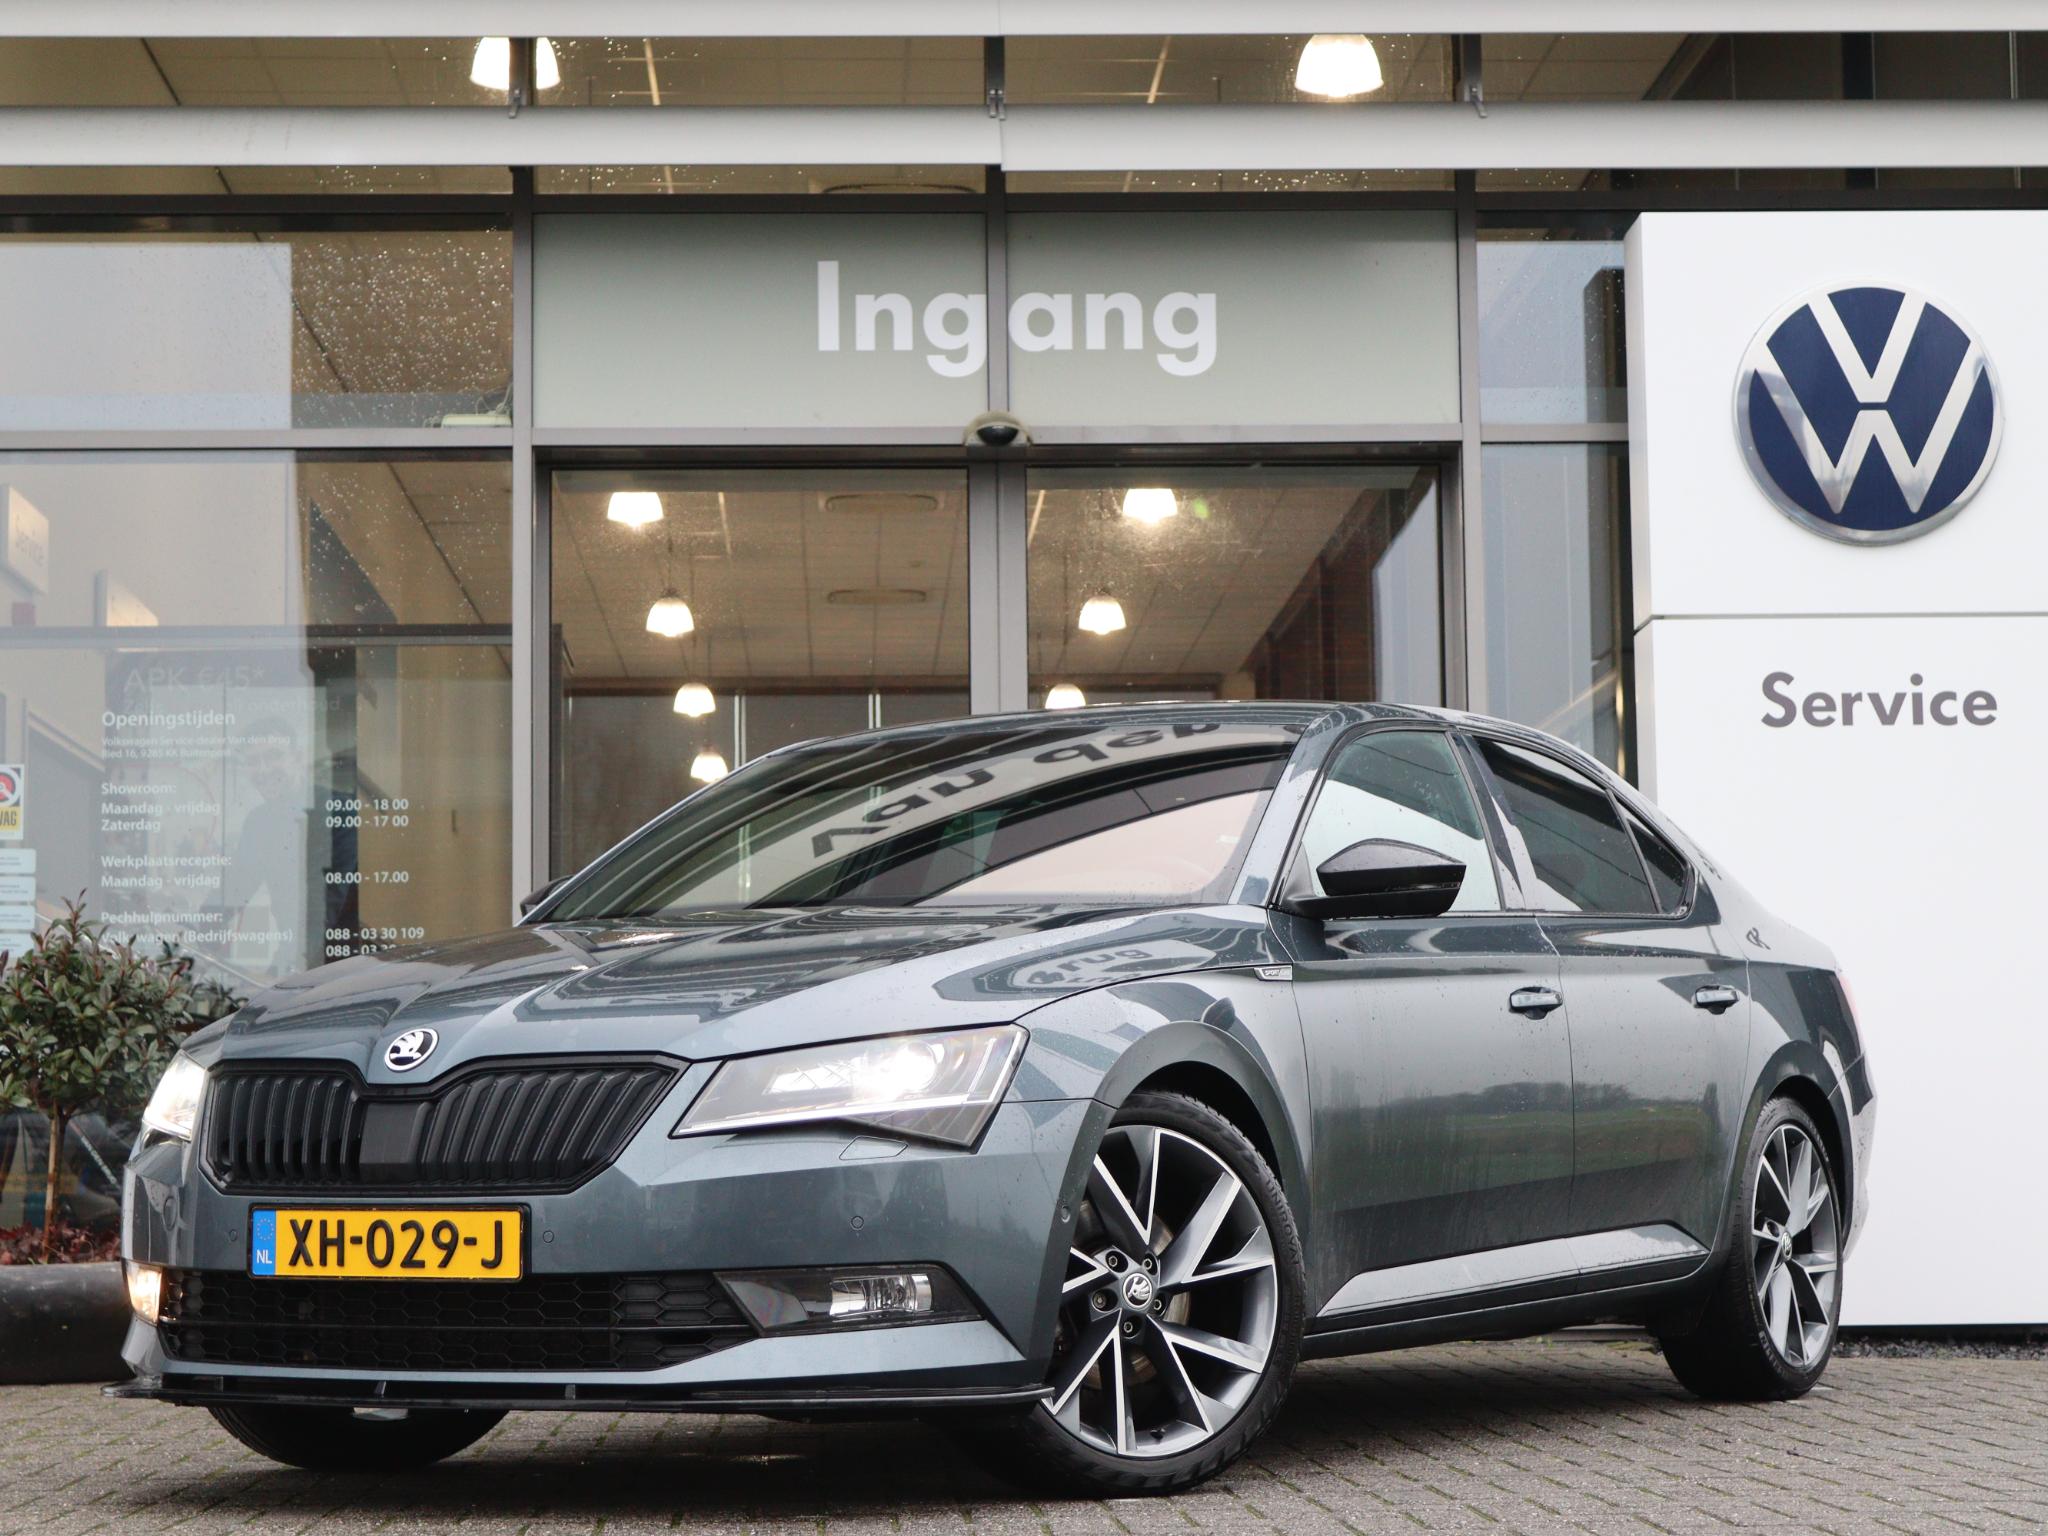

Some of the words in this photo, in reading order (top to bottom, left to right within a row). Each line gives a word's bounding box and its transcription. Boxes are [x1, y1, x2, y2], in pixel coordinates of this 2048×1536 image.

[817, 260, 1217, 377] Ingang
[122, 667, 188, 693] APK
[1760, 671, 1998, 728] Service
[101, 711, 236, 730] Openingstijden
[101, 782, 176, 796] Showroom:
[101, 801, 163, 816] Maandag
[174, 800, 220, 816] vrijdag
[325, 799, 362, 812] 09.00
[101, 818, 160, 833] Zaterdag
[325, 815, 362, 828] 09.00
[101, 855, 232, 870] Werkplaatsreceptie:
[101, 874, 163, 889] Maandag
[174, 873, 220, 889] vrijdag
[325, 872, 362, 884] 08.00
[374, 871, 409, 884] 17.00
[101, 911, 223, 927] Pechhulpnummer:
[101, 930, 181, 945] Volkwagen
[183, 928, 293, 946] (Bedrijfswagens)
[325, 928, 350, 940] 088
[361, 927, 377, 940] 03
[380, 927, 397, 940] 30
[401, 926, 425, 939] 109
[325, 944, 351, 957] 088
[288, 1218, 503, 1269] XH-029-J
[256, 1249, 273, 1265] NL
